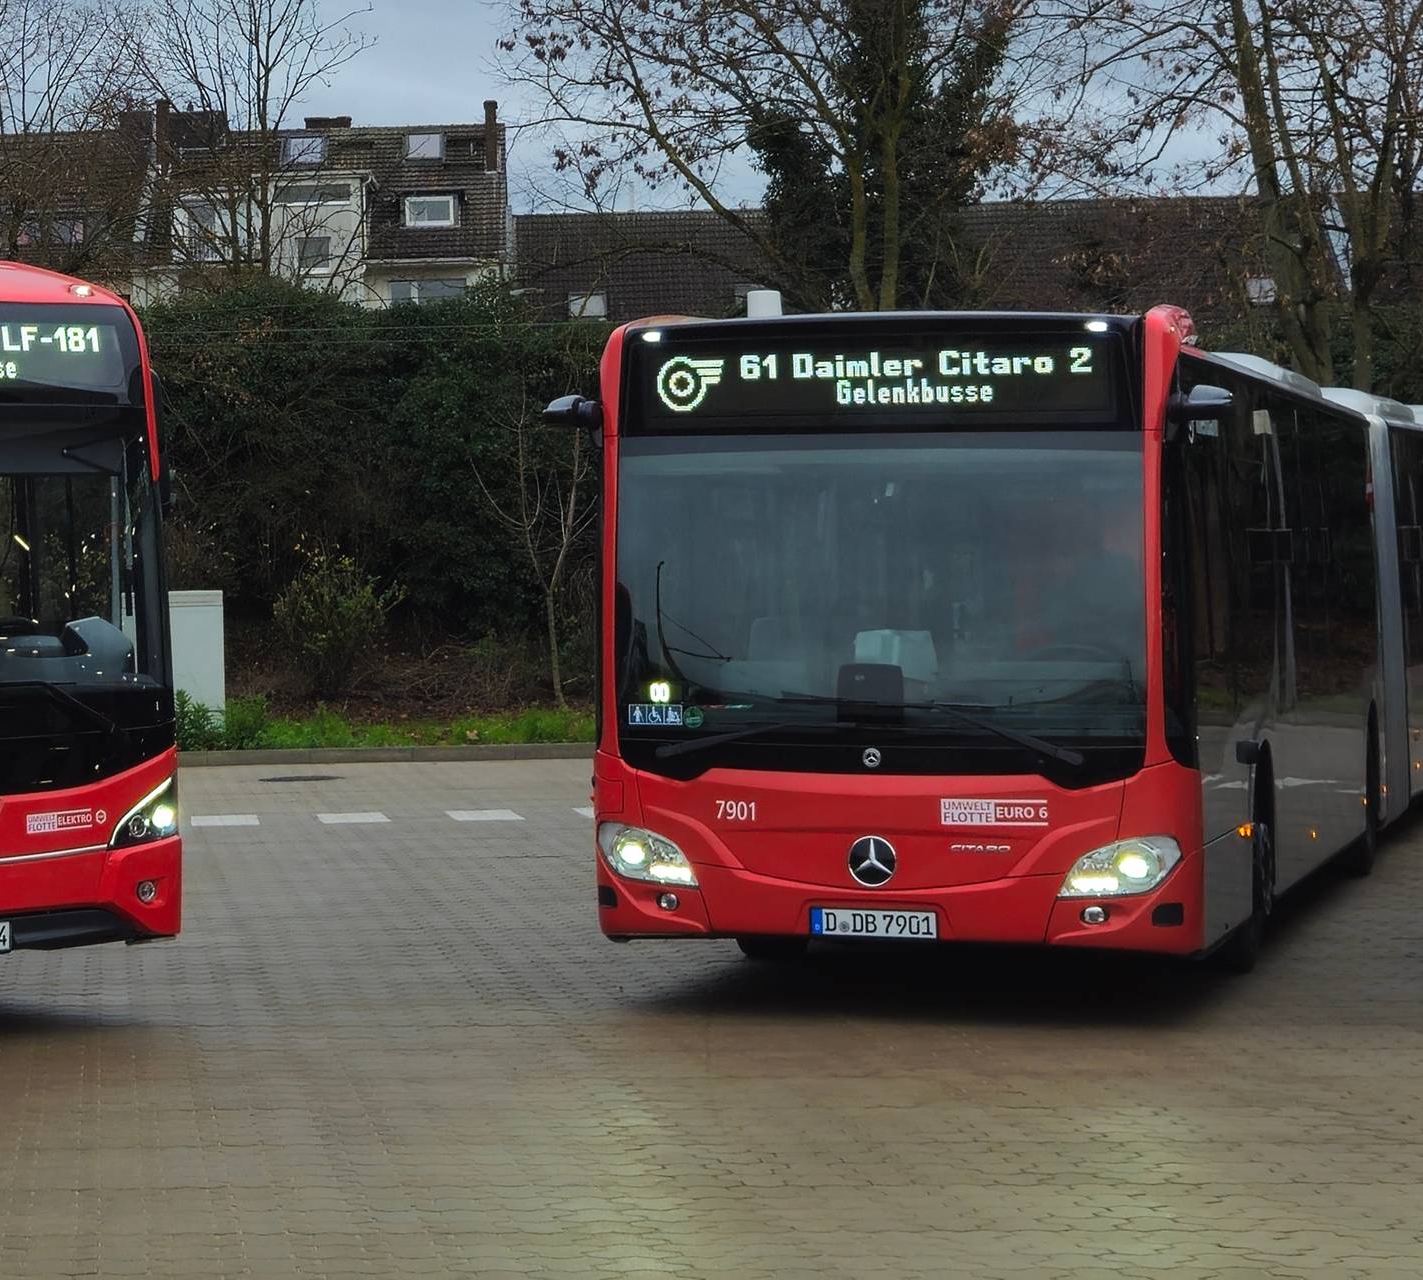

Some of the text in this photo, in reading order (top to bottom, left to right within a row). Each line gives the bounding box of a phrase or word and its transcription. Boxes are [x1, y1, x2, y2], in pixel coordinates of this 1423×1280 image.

[0, 325, 100, 352] LF-181
[739, 347, 1092, 379] 61 Daimler Citaro 2
[836, 378, 993, 405] Gelenkbusse
[649, 682, 670, 702] 00
[715, 800, 755, 821] 7901
[943, 801, 992, 811] UMWELT
[996, 806, 1048, 819] EURO 6
[28, 821, 56, 832] FLOTTE
[57, 813, 93, 827] ELEKTRO
[943, 812, 993, 823] FLOTTE
[824, 912, 934, 935] D DB 7901
